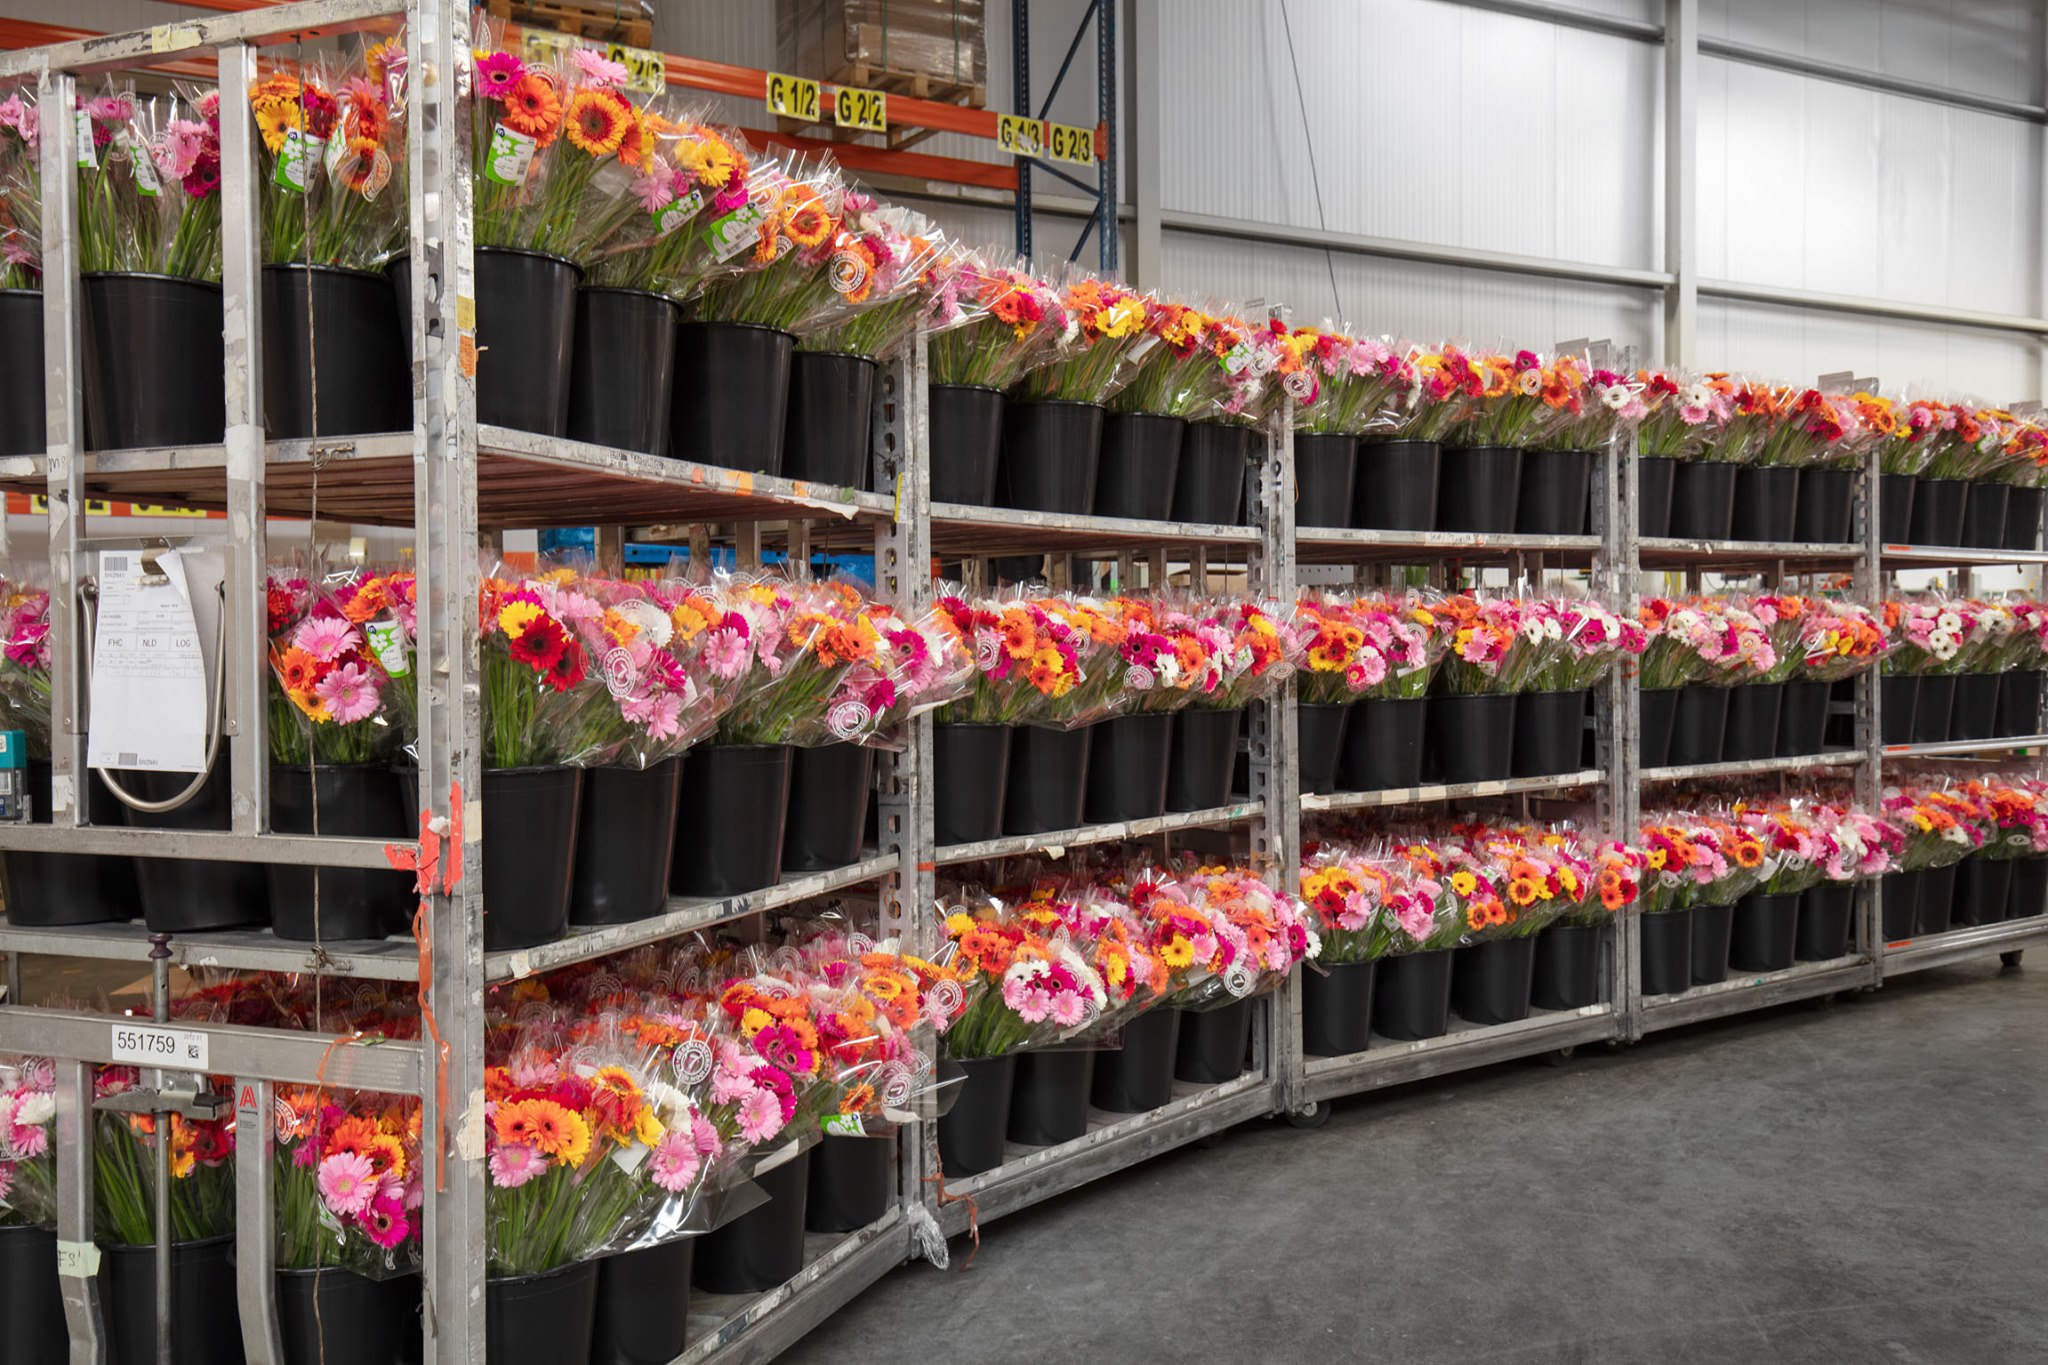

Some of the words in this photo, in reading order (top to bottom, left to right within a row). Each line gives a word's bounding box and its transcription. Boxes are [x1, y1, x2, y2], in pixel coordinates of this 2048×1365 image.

[771, 77, 784, 110] G
[791, 81, 815, 116] 1/2
[839, 91, 852, 122] G
[857, 93, 882, 126] 2/2
[1001, 118, 1012, 147] G
[1053, 127, 1063, 156] G
[1069, 130, 1090, 161] 2/3
[108, 639, 123, 648] FHC
[142, 639, 157, 647] NLD
[176, 639, 191, 648] LOG
[118, 1032, 175, 1054] 551759
